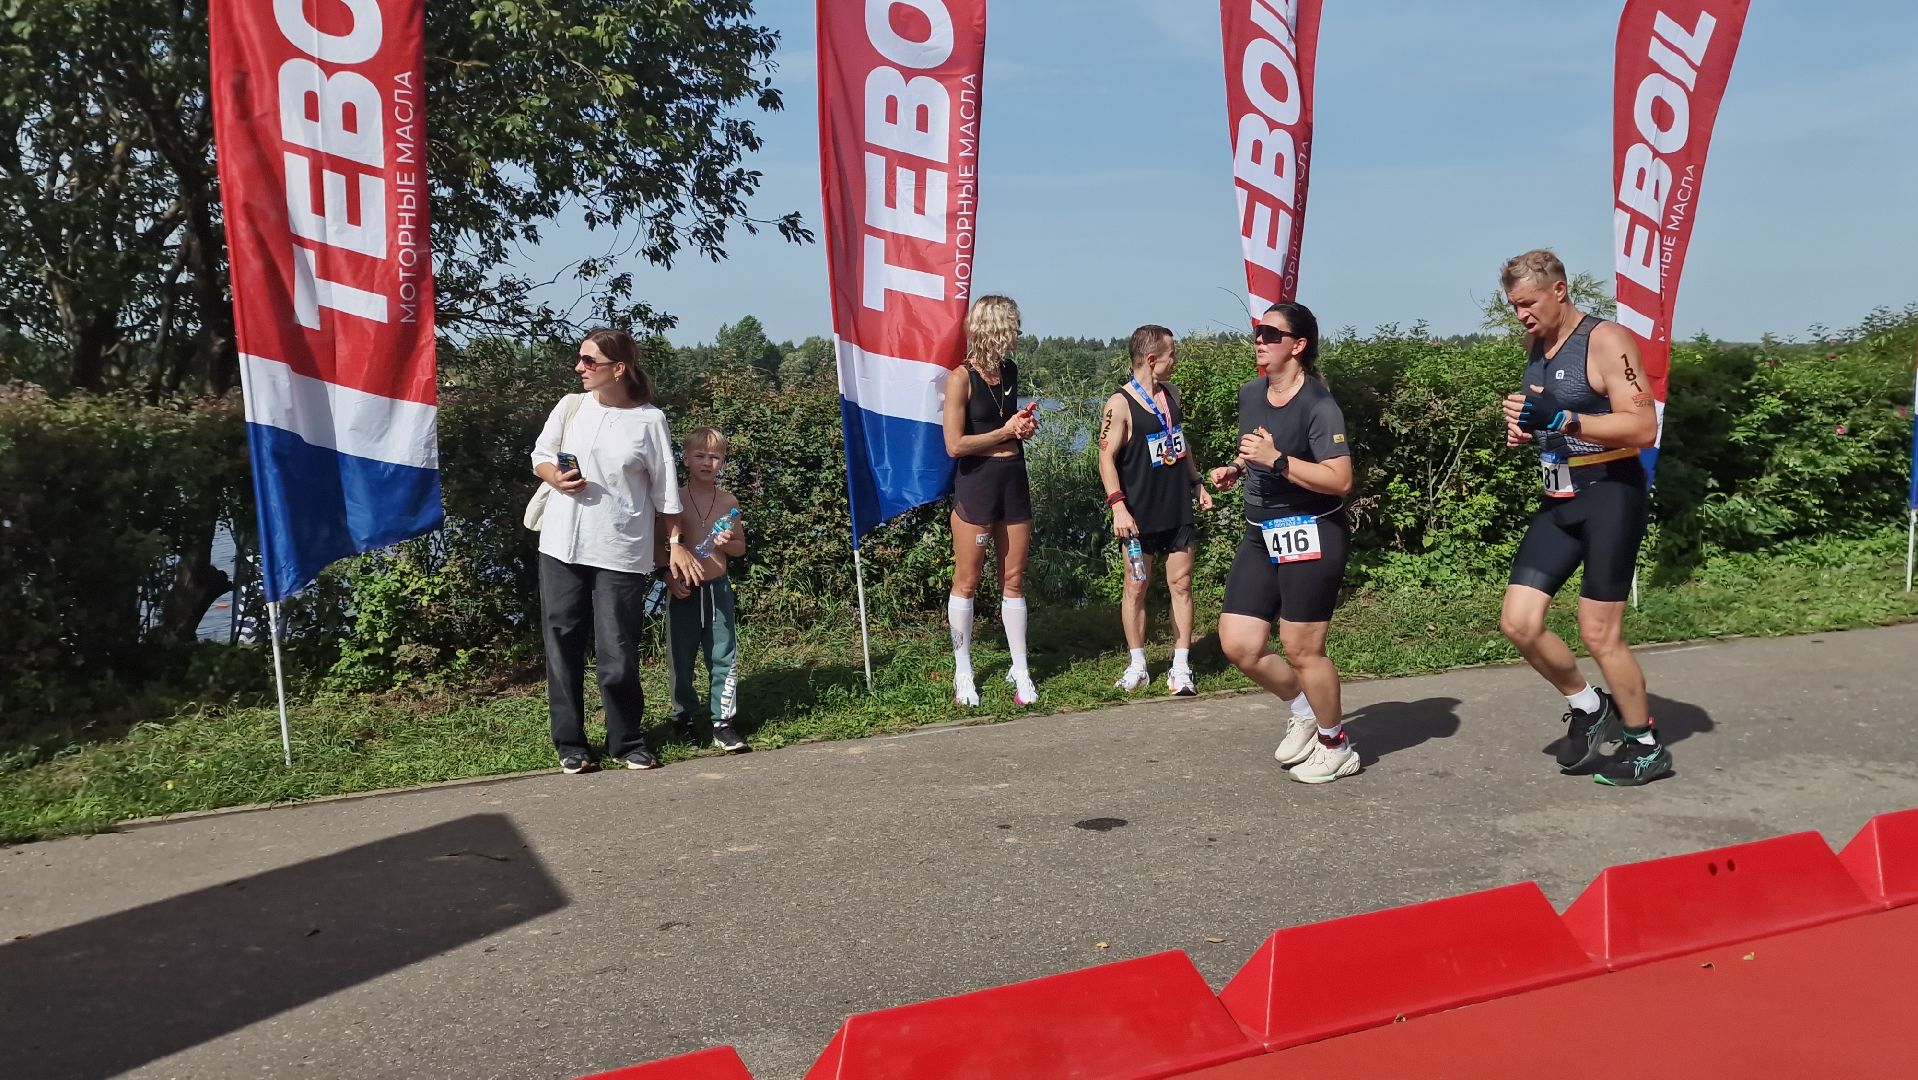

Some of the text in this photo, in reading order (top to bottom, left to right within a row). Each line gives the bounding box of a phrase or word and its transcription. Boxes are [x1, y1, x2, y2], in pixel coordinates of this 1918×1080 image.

[393, 71, 417, 324] МОТОРНЫЕ МАСЛА
[954, 73, 976, 300] МОТОРНЫЕ МАСЛА
[1666, 164, 1695, 232] МАСЛА
[1620, 353, 1642, 392] 181
[1100, 409, 1113, 439] 425
[1155, 436, 1183, 459] 45
[1272, 528, 1310, 555] 416
